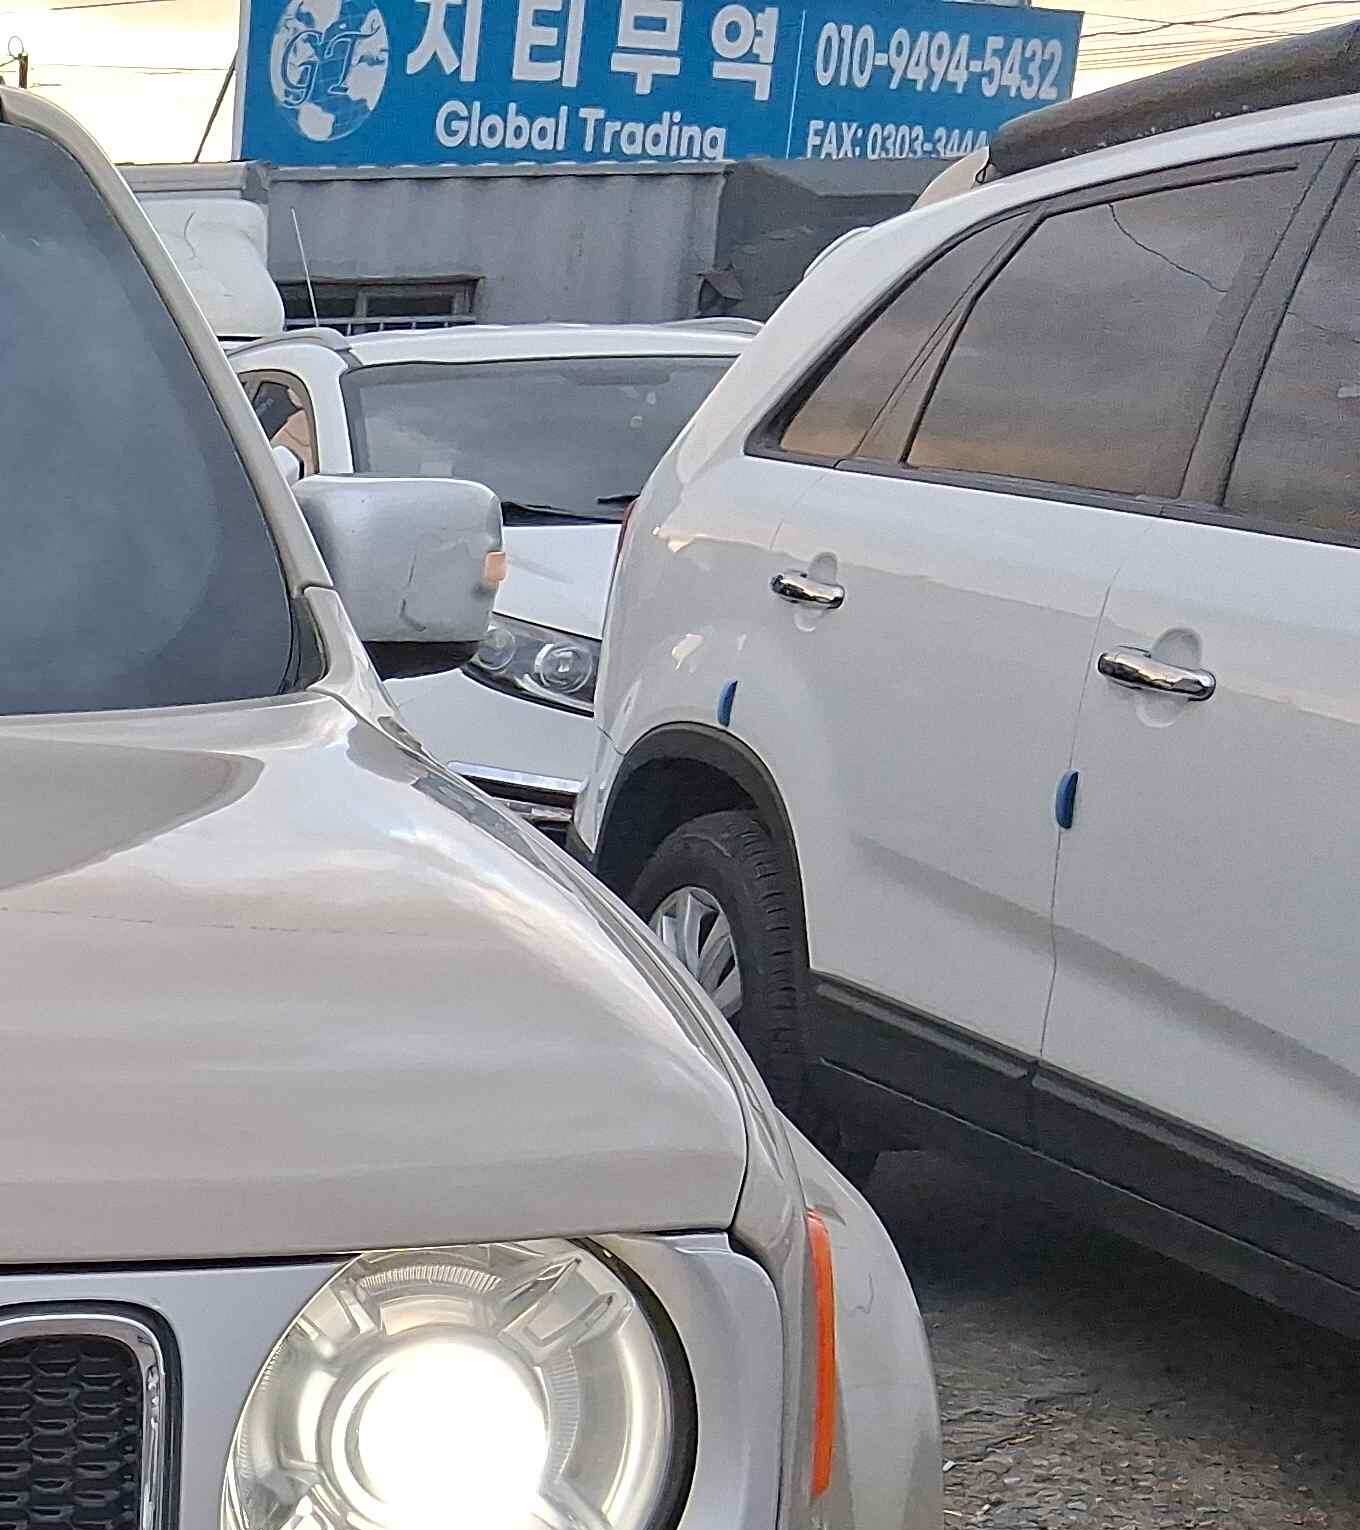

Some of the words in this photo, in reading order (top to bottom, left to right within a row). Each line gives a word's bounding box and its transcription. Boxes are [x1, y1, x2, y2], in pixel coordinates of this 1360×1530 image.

[406, 0, 780, 101] 지티무역
[816, 22, 1063, 100] 010-9494-5432
[435, 100, 568, 150] Global
[580, 108, 727, 159] Trading
[807, 120, 863, 160] FAX:
